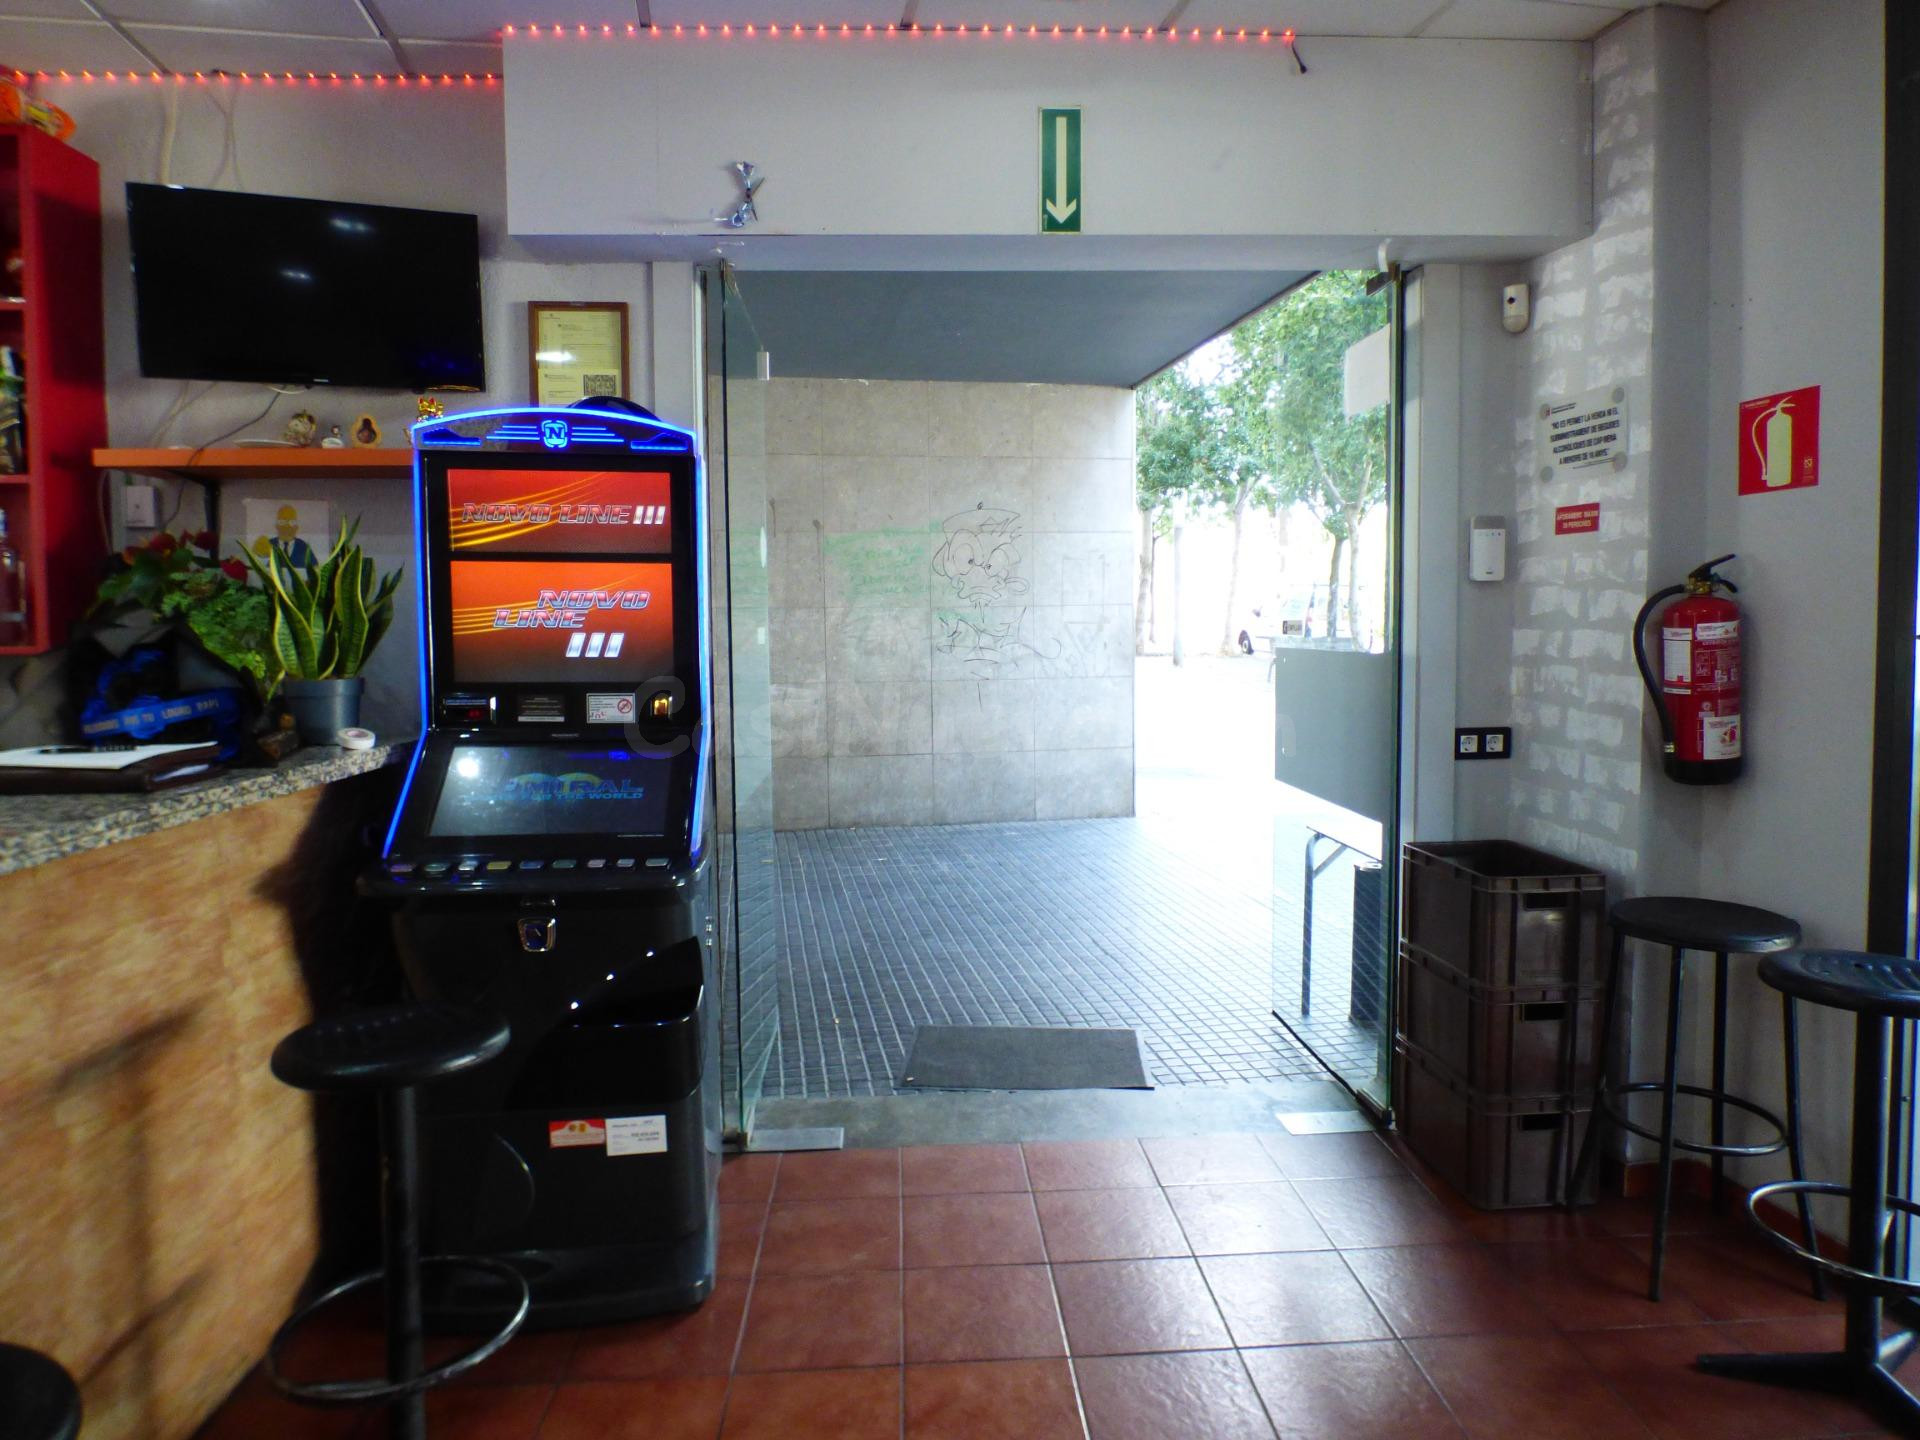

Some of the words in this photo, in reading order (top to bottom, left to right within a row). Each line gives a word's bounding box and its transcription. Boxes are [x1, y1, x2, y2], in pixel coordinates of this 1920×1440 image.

[462, 502, 552, 524] NOVO
[558, 503, 632, 525] LINE
[537, 588, 651, 609] NOVO
[493, 608, 589, 629] LINE
